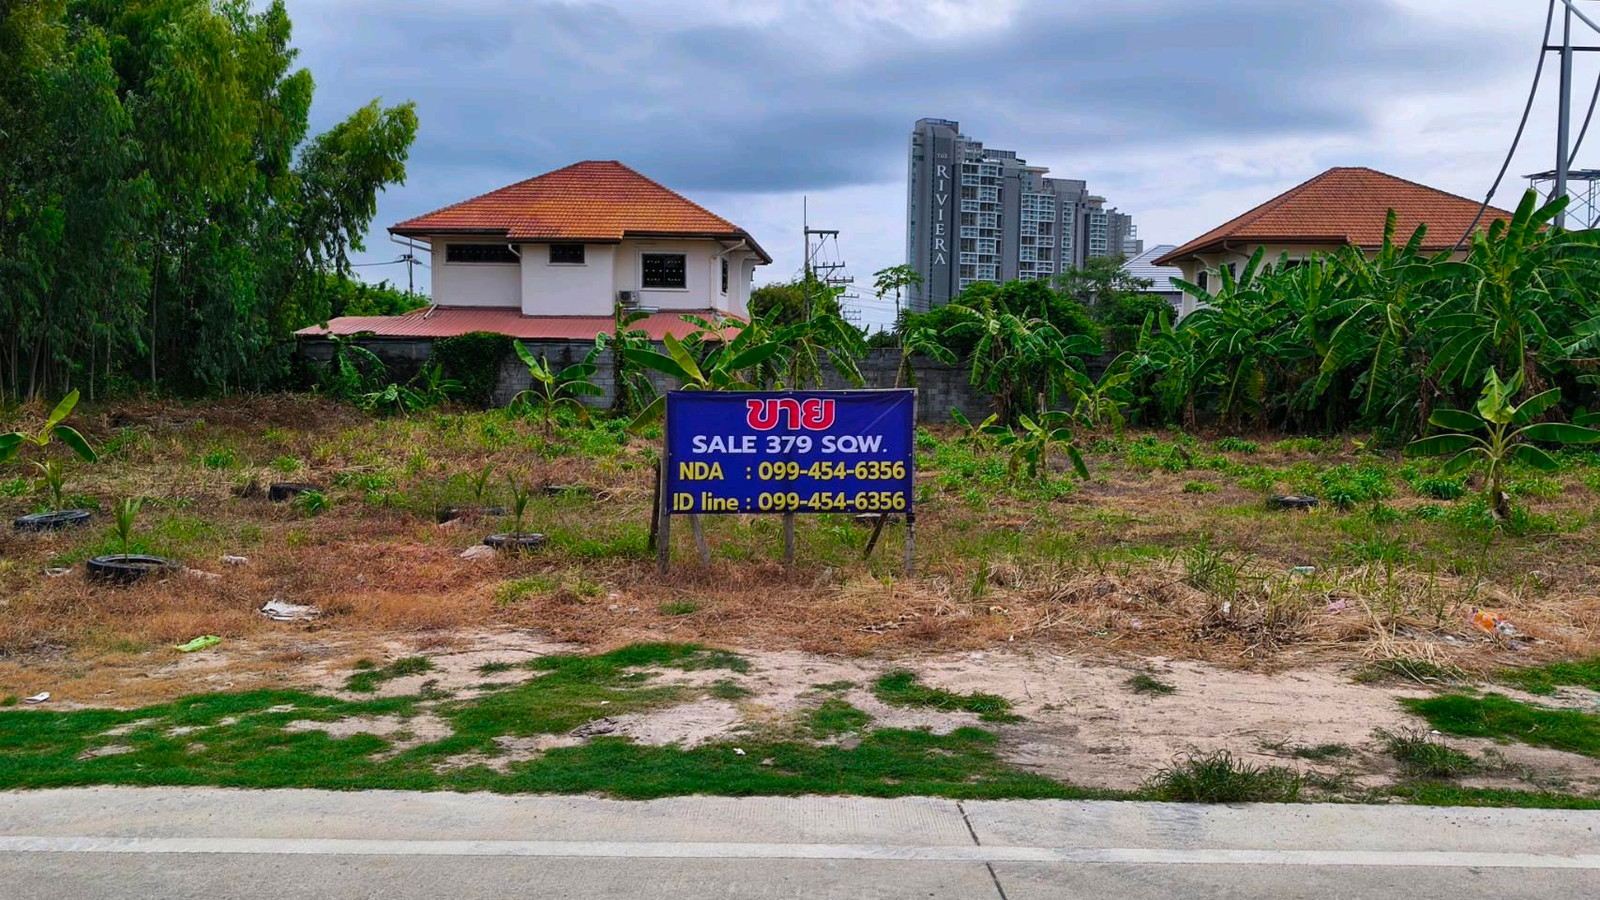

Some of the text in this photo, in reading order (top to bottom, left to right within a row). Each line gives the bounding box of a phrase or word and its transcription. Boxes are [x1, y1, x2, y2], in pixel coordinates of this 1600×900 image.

[934, 164, 950, 265] RIVIERA
[746, 398, 835, 431] ขาย
[692, 435, 888, 454] SALE 379 SQW.
[679, 461, 725, 481] NDA
[758, 461, 906, 481] 099-454-6356
[673, 492, 694, 511] ID
[701, 492, 739, 511] line
[758, 491, 906, 511] 099-454-6356
